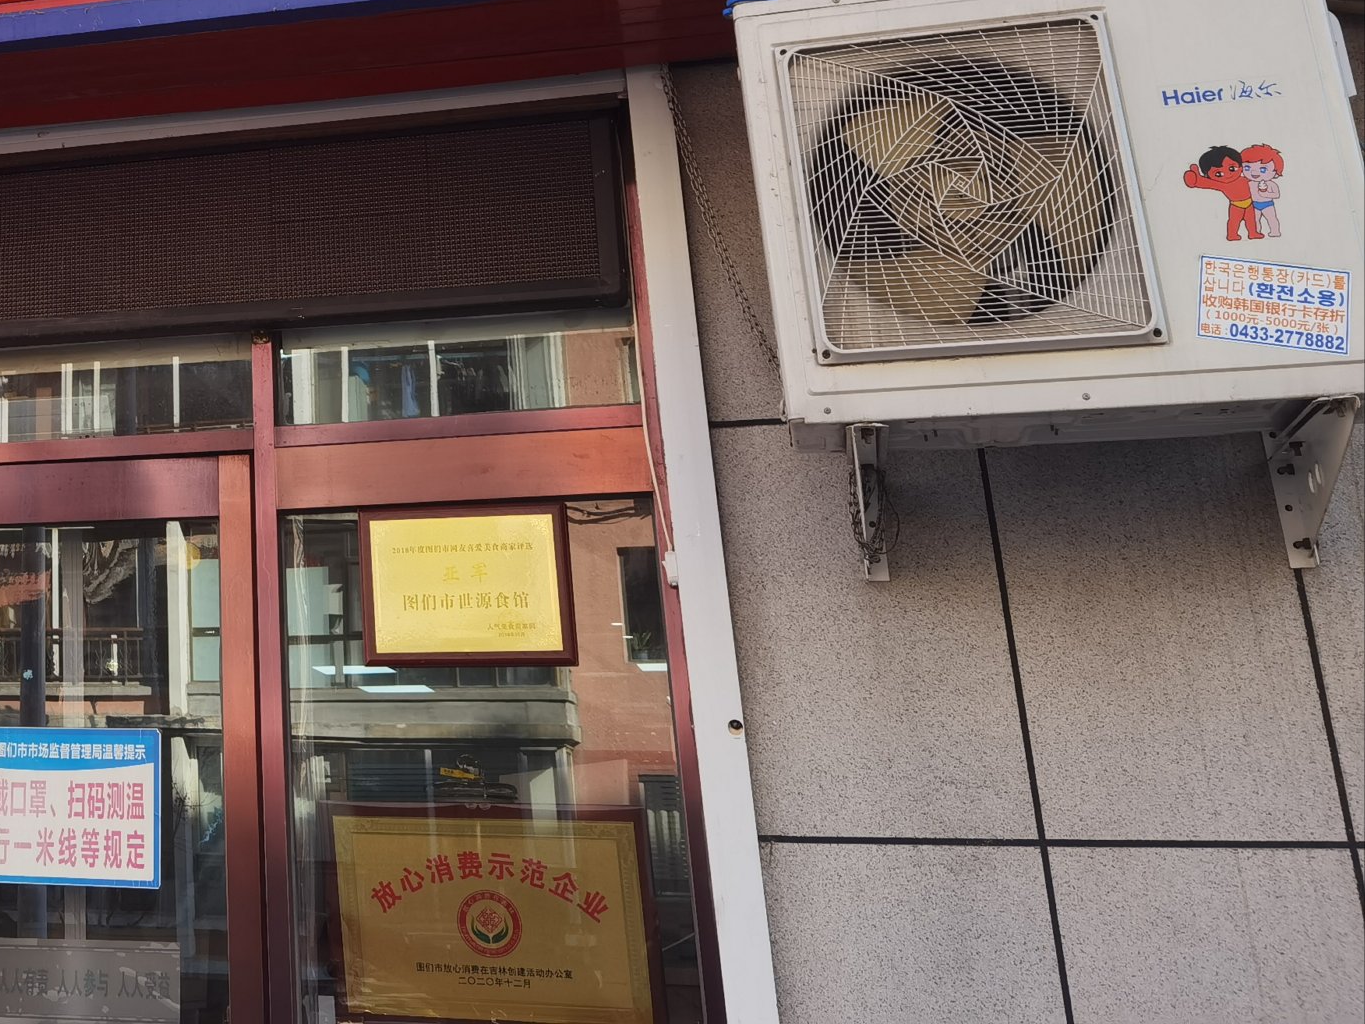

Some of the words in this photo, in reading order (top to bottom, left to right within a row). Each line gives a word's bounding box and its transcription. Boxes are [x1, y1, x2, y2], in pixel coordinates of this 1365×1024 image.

[1162, 86, 1224, 106] Haier
[1202, 294, 1346, 323] 收购韩国银行卡存折
[1229, 323, 1345, 351] 0433-2778882
[402, 590, 530, 612] 图们市世源食馆
[370, 851, 610, 924] 放心消费示范企业
[57, 968, 109, 998] 人人参与
[416, 962, 574, 980] 图们市放心消费在吉林创建活动办公室
